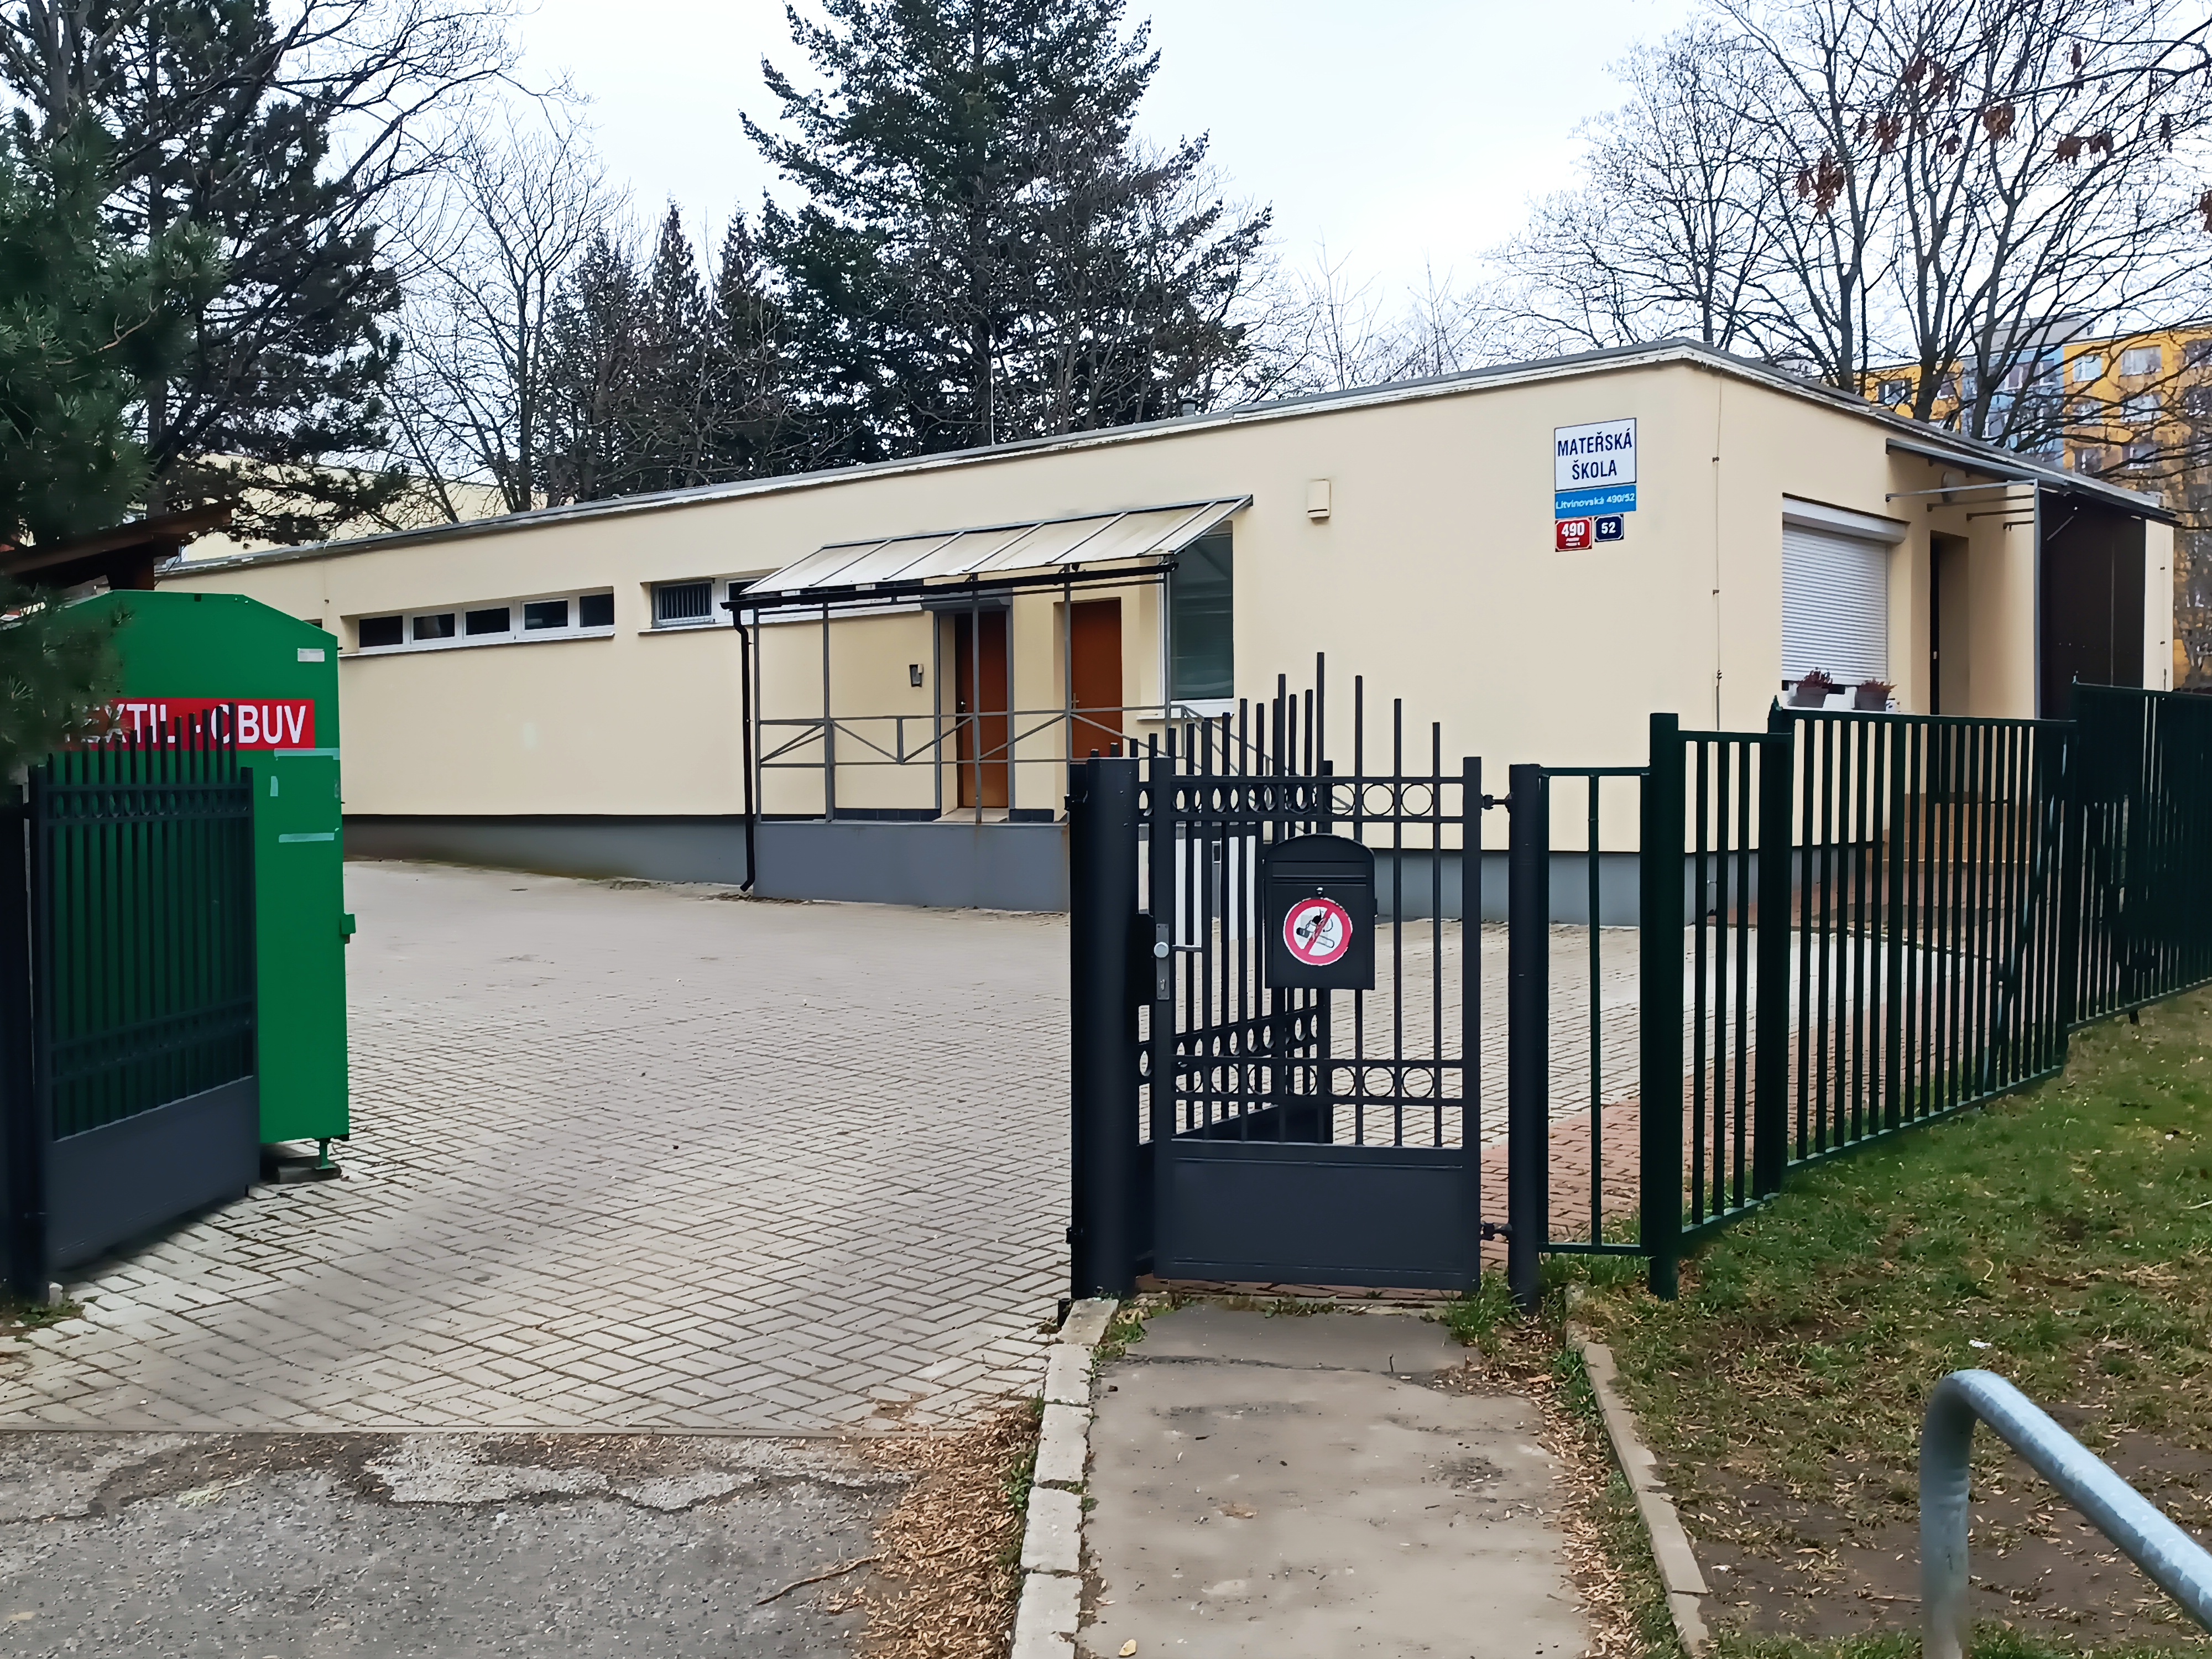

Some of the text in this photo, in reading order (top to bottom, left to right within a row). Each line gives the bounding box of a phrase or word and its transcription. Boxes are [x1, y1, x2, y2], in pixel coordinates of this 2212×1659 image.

[1557, 427, 1632, 457] MATEŘSKÁ
[1572, 459, 1617, 480] ŠKOLA
[1556, 493, 1635, 509] Litvinovská 490/52
[1561, 521, 1585, 537] 490
[1601, 521, 1616, 534] 52
